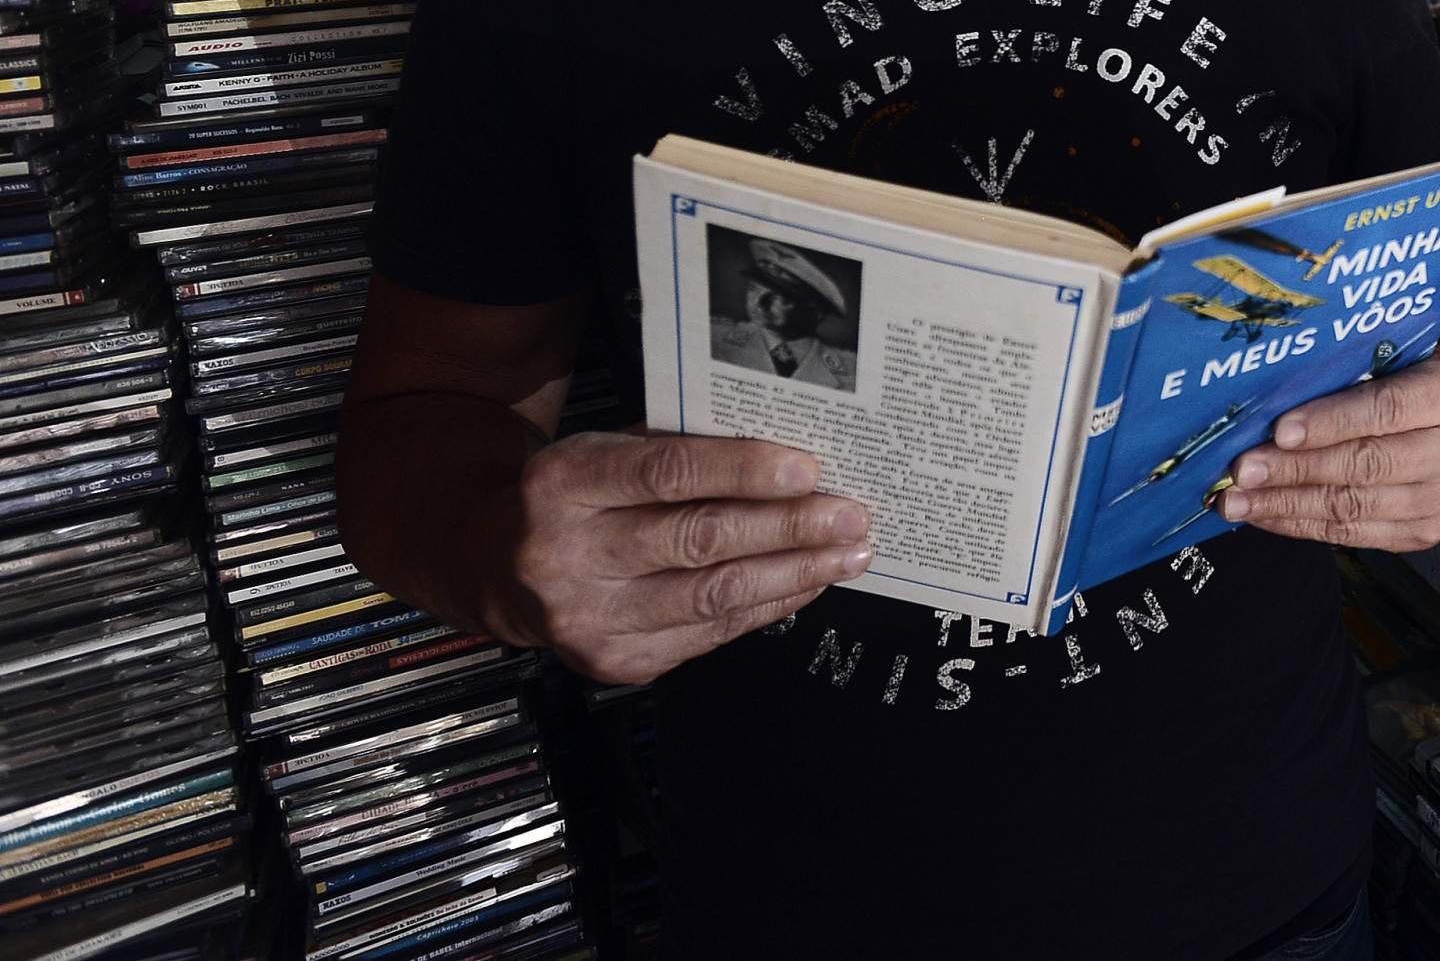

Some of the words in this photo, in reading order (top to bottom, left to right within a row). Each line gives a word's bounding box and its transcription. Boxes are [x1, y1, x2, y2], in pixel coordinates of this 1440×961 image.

[186, 40, 244, 52] AUDIO
[218, 77, 252, 88] KENNY
[266, 72, 294, 82] FAITH
[298, 70, 307, 78] A
[307, 65, 349, 77] HOLIDAY
[349, 61, 382, 72] ALBUM
[222, 95, 267, 107] PACHELBEL
[269, 92, 291, 101] BACH
[955, 29, 1230, 165] EXPLORERS
[154, 168, 182, 180] Barros
[1344, 196, 1418, 232] ERNST
[1341, 262, 1428, 310] VIDA
[14, 294, 56, 311] VOLUME
[1160, 368, 1188, 400] E
[1200, 327, 1318, 387] MEUS
[1332, 286, 1437, 342] VÔOS
[109, 467, 153, 487] SONY
[309, 625, 353, 647] SAUDADE
[369, 610, 412, 630] TOM
[363, 640, 393, 656] RODA
[321, 893, 352, 910] NAXOS
[443, 853, 467, 867] Music
